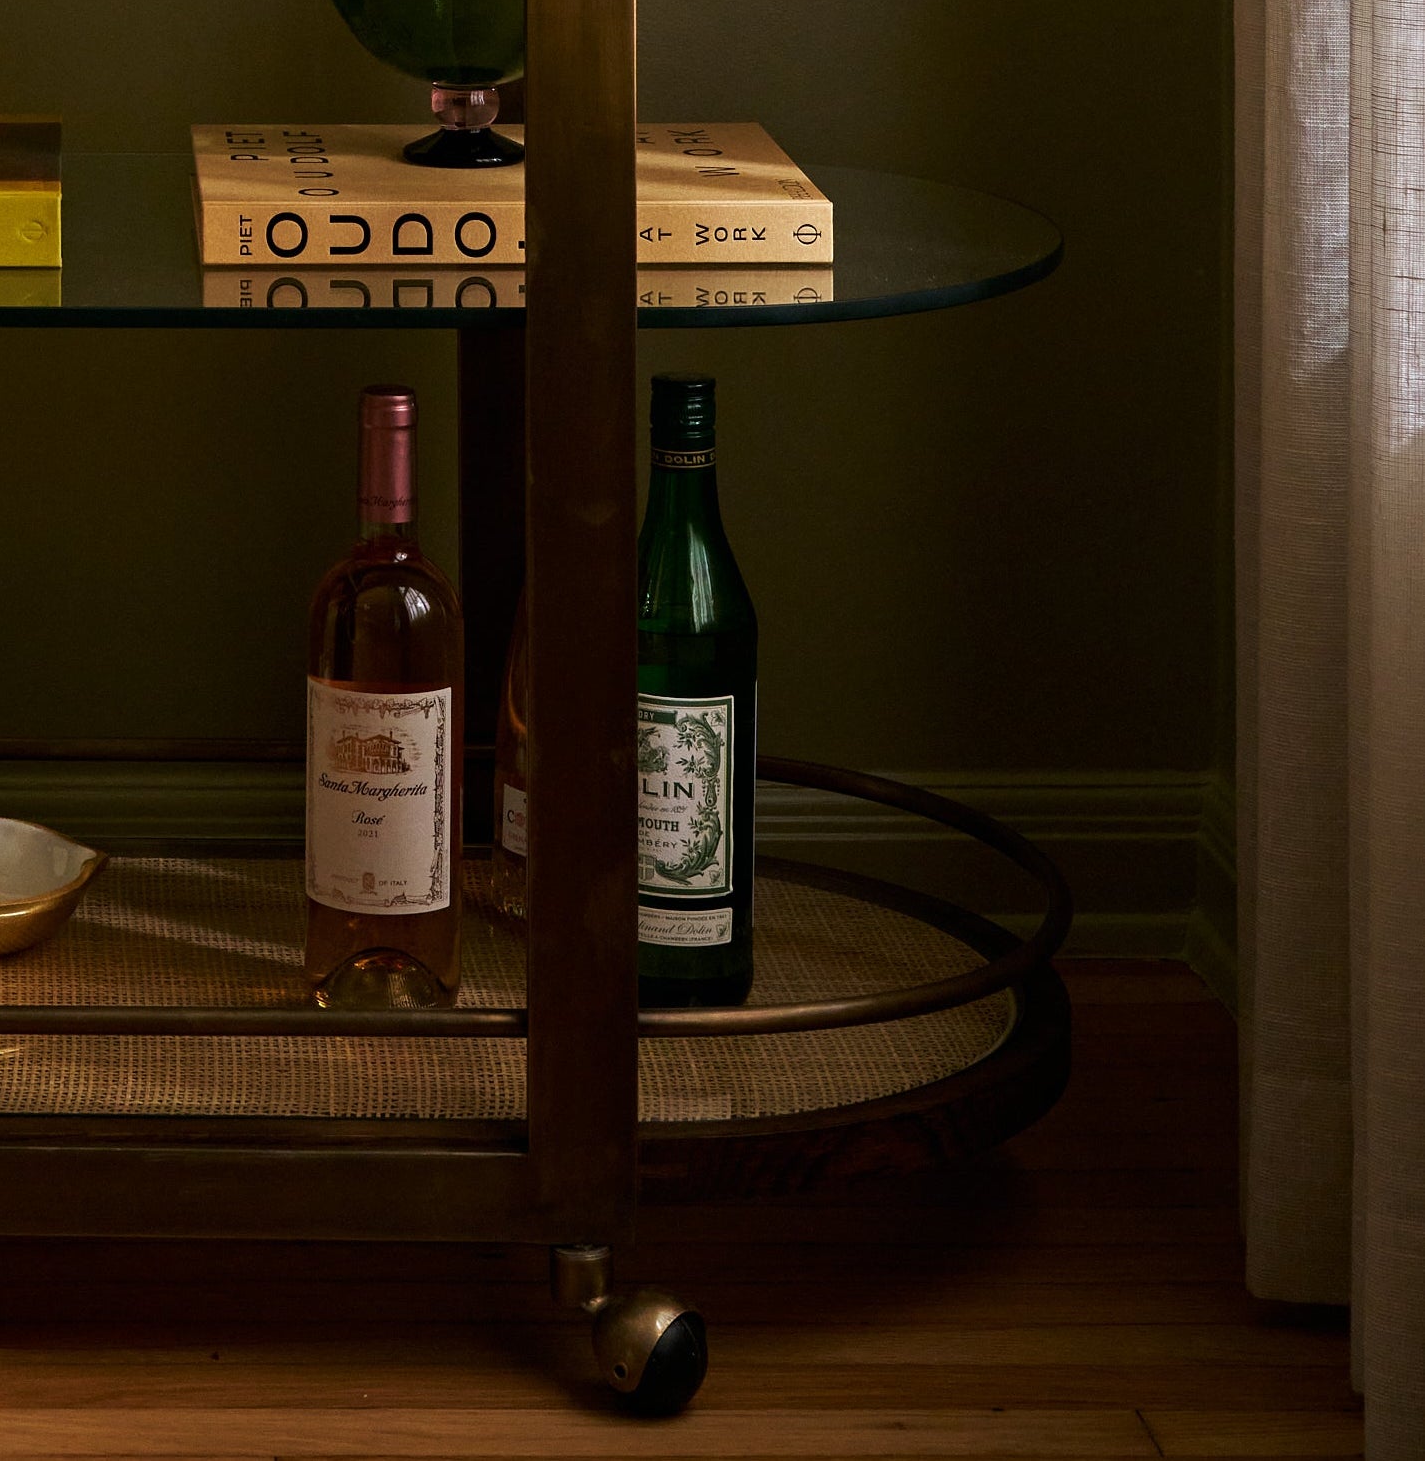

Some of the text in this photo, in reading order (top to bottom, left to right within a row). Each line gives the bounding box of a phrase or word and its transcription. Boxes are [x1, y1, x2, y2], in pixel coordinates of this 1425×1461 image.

[225, 130, 269, 161] PIET
[666, 129, 741, 178] WORK
[282, 130, 340, 198] OUDOLF
[239, 214, 253, 256] PIET
[266, 212, 525, 258] OUDO
[639, 223, 766, 246] AT WORK
[664, 454, 706, 464] DOLIN
[319, 772, 428, 801] Santa Margherita
[642, 778, 694, 799] LIN
[352, 811, 385, 825] Rosé
[357, 829, 378, 838] 2021
